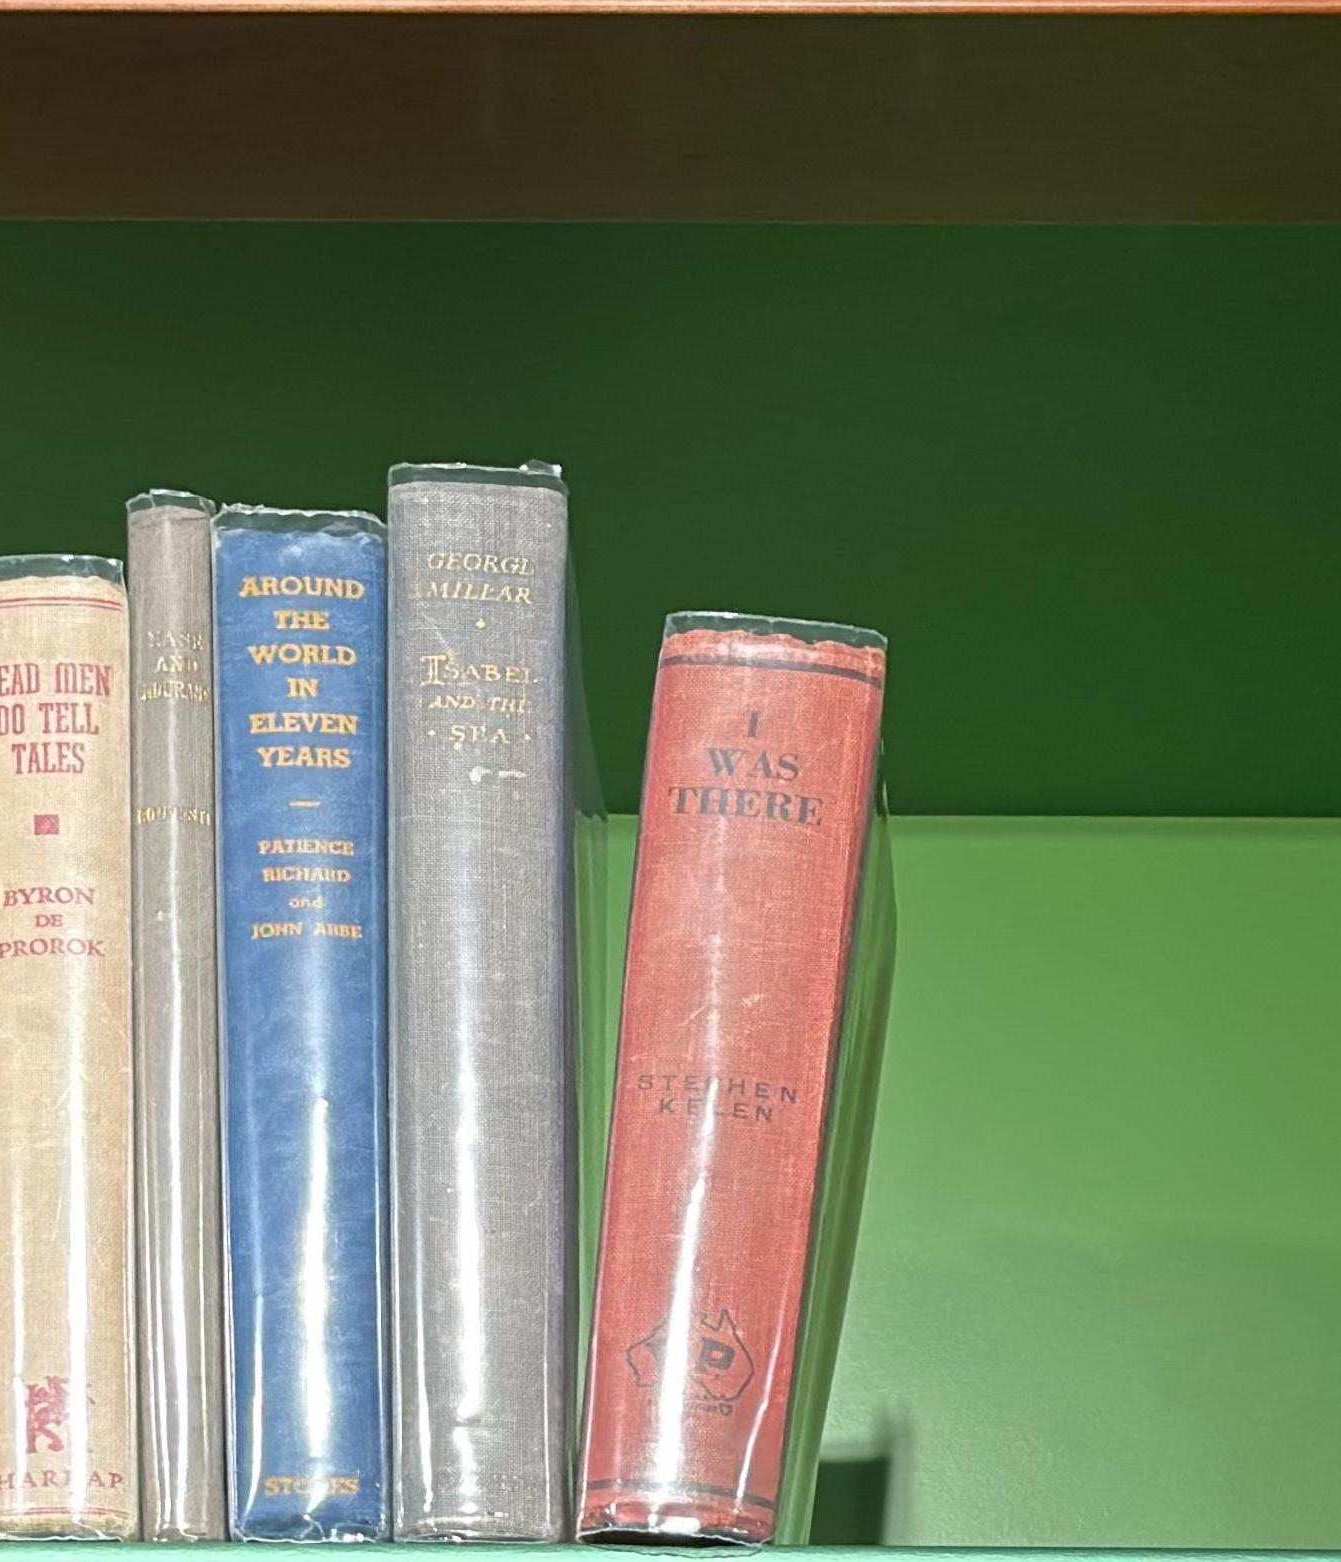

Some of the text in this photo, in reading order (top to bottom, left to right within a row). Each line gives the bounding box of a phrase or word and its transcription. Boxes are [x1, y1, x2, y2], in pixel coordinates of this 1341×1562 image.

[238, 576, 365, 599] AROUND
[418, 582, 533, 604] MILLAR
[274, 610, 330, 630] THE
[248, 643, 357, 665] WORLD
[54, 662, 111, 698] MEN
[285, 677, 320, 697] IN
[429, 695, 475, 709] AND
[38, 702, 99, 736] TELL
[249, 712, 358, 735] ELEVEN
[747, 711, 759, 738] I
[11, 742, 85, 775] TALES
[256, 746, 351, 768] YEARS
[707, 748, 800, 781] WAS
[668, 786, 824, 826] THERE
[258, 839, 355, 856] PATIENCE
[262, 867, 352, 882] RICHARD
[3, 887, 95, 908] BYRON
[288, 896, 324, 909] and
[35, 914, 63, 928] DE
[251, 922, 303, 940] JOHN
[264, 1475, 359, 1496] STOES
